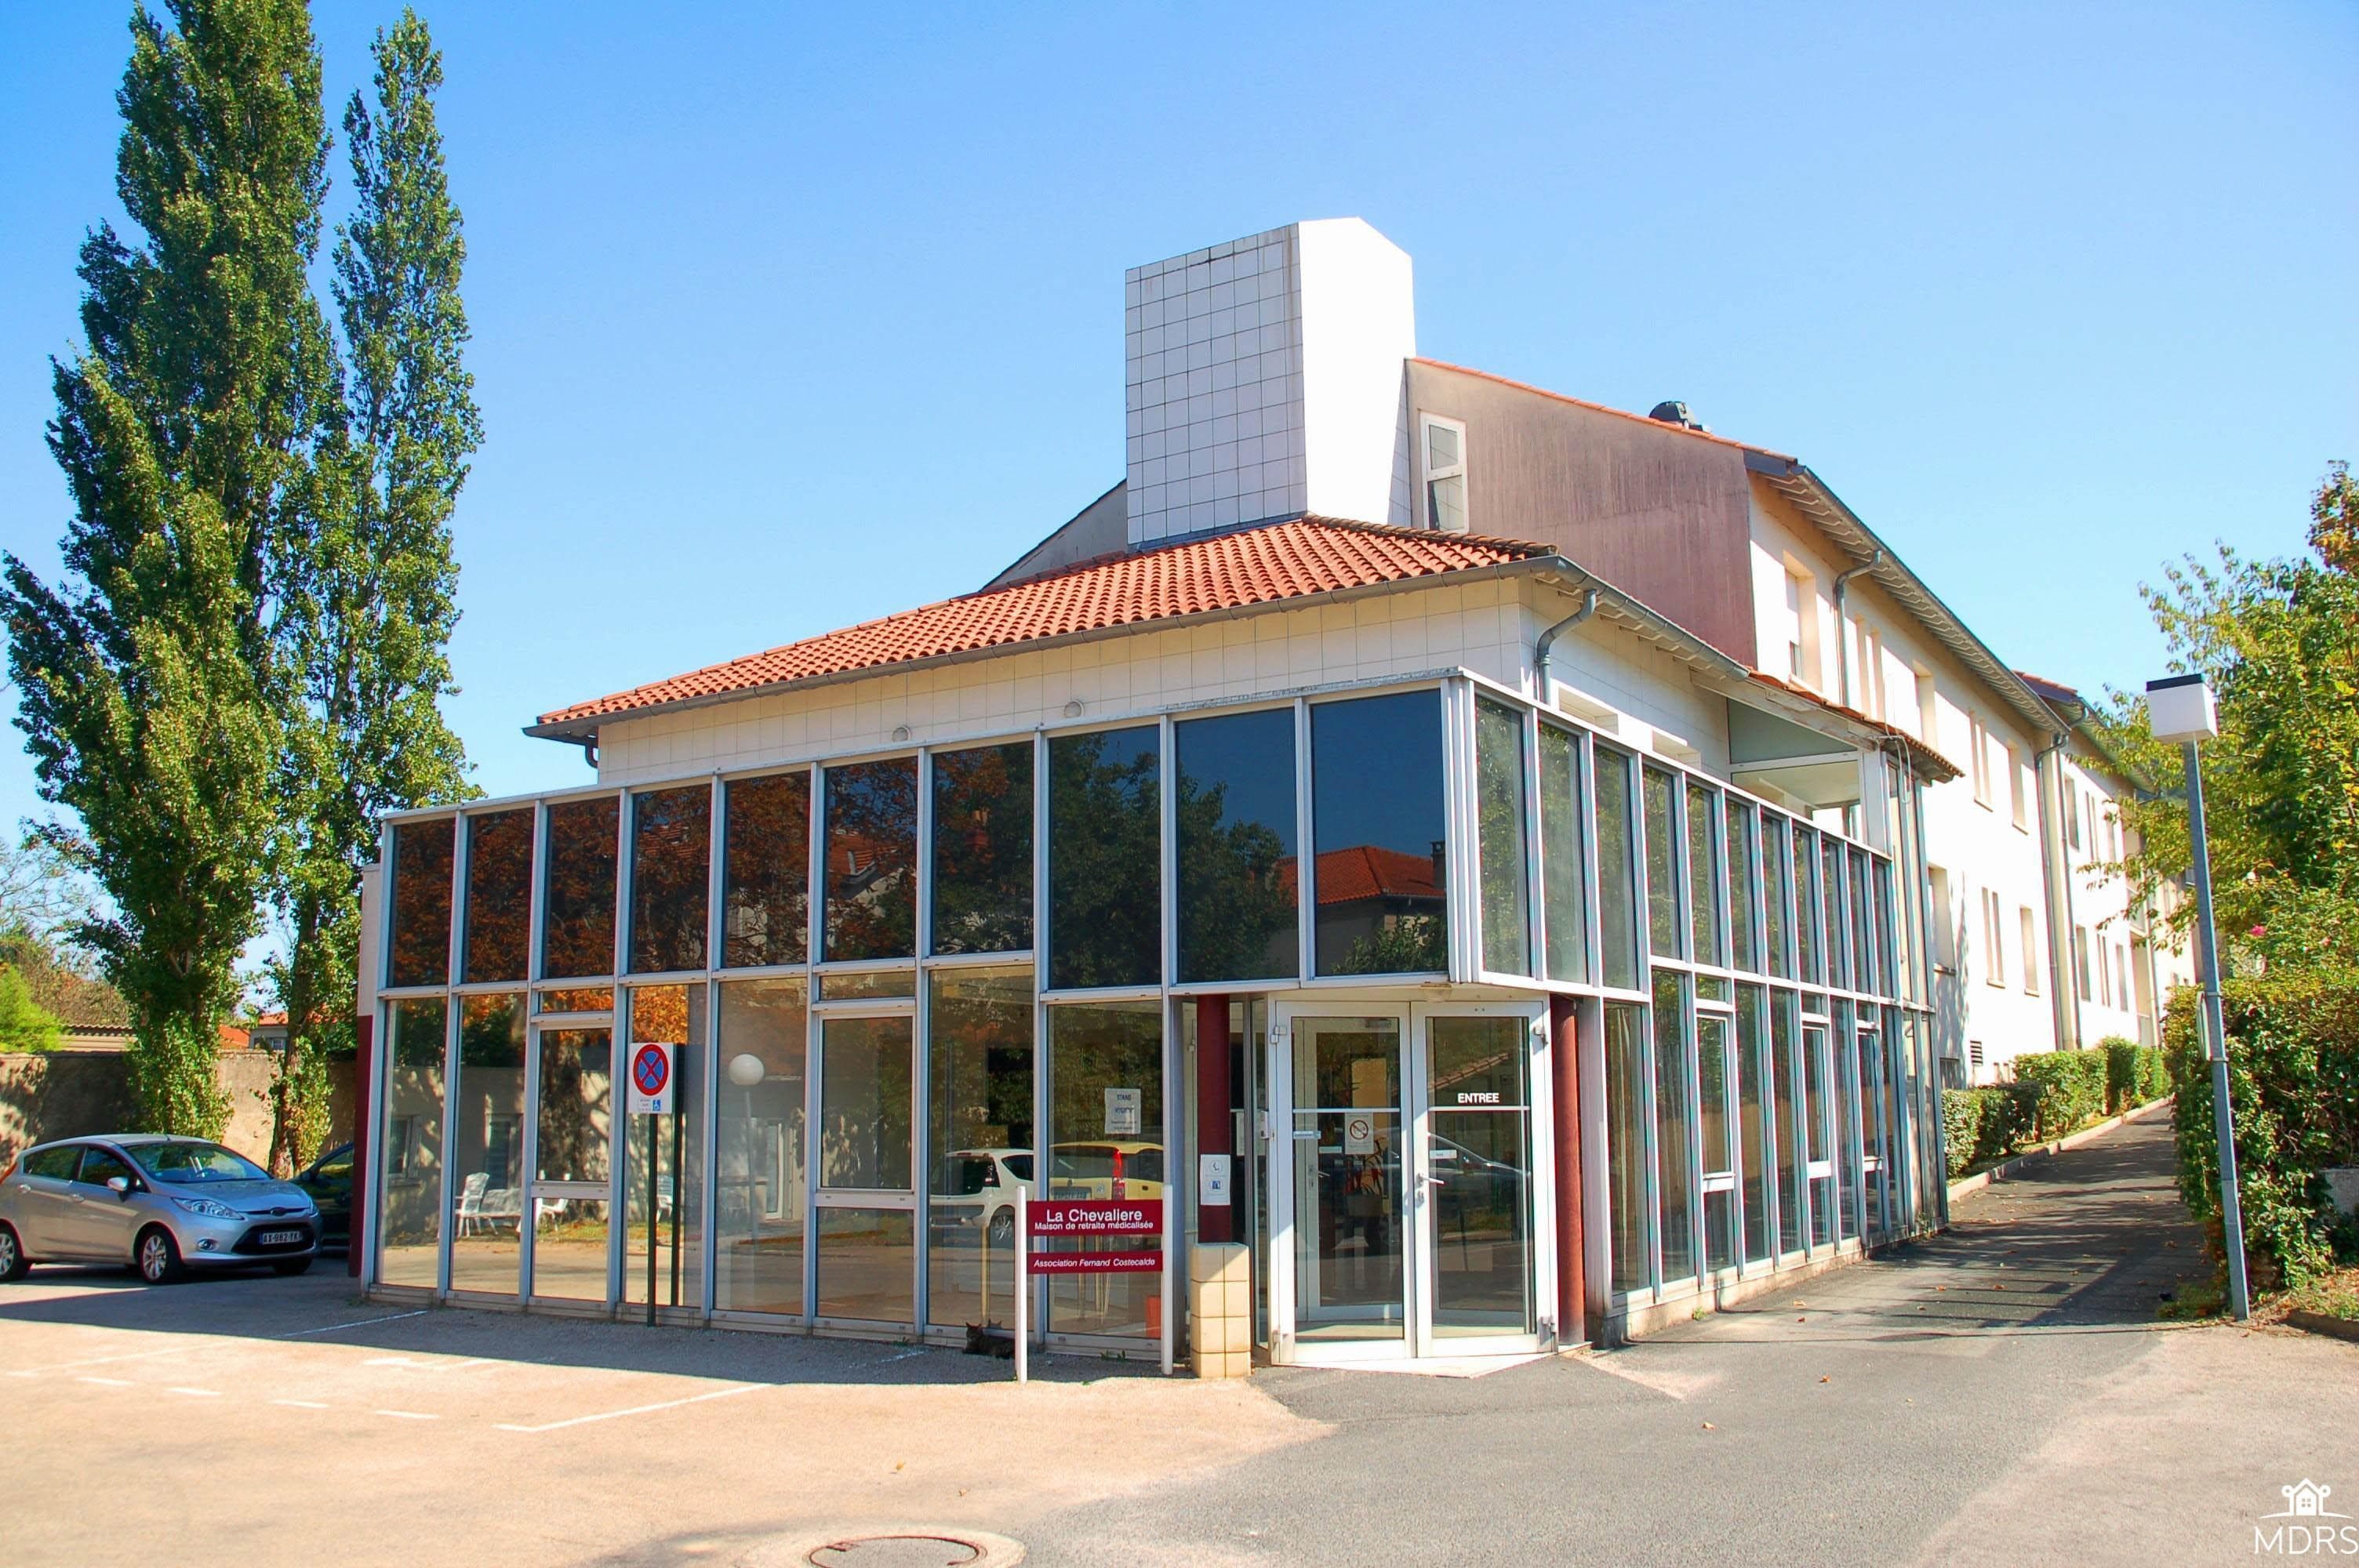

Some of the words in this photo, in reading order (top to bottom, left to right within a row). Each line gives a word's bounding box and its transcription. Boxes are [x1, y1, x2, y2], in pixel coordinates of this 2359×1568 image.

[1457, 1092, 1499, 1104] ENTREE
[1046, 1209, 1063, 1222] La
[1034, 1221, 1063, 1230] Maison
[1107, 1221, 1154, 1229] médicalisée
[1034, 1258, 1078, 1268] Association
[1078, 1258, 1110, 1267] Fernand
[1113, 1258, 1155, 1266] Costecalde
